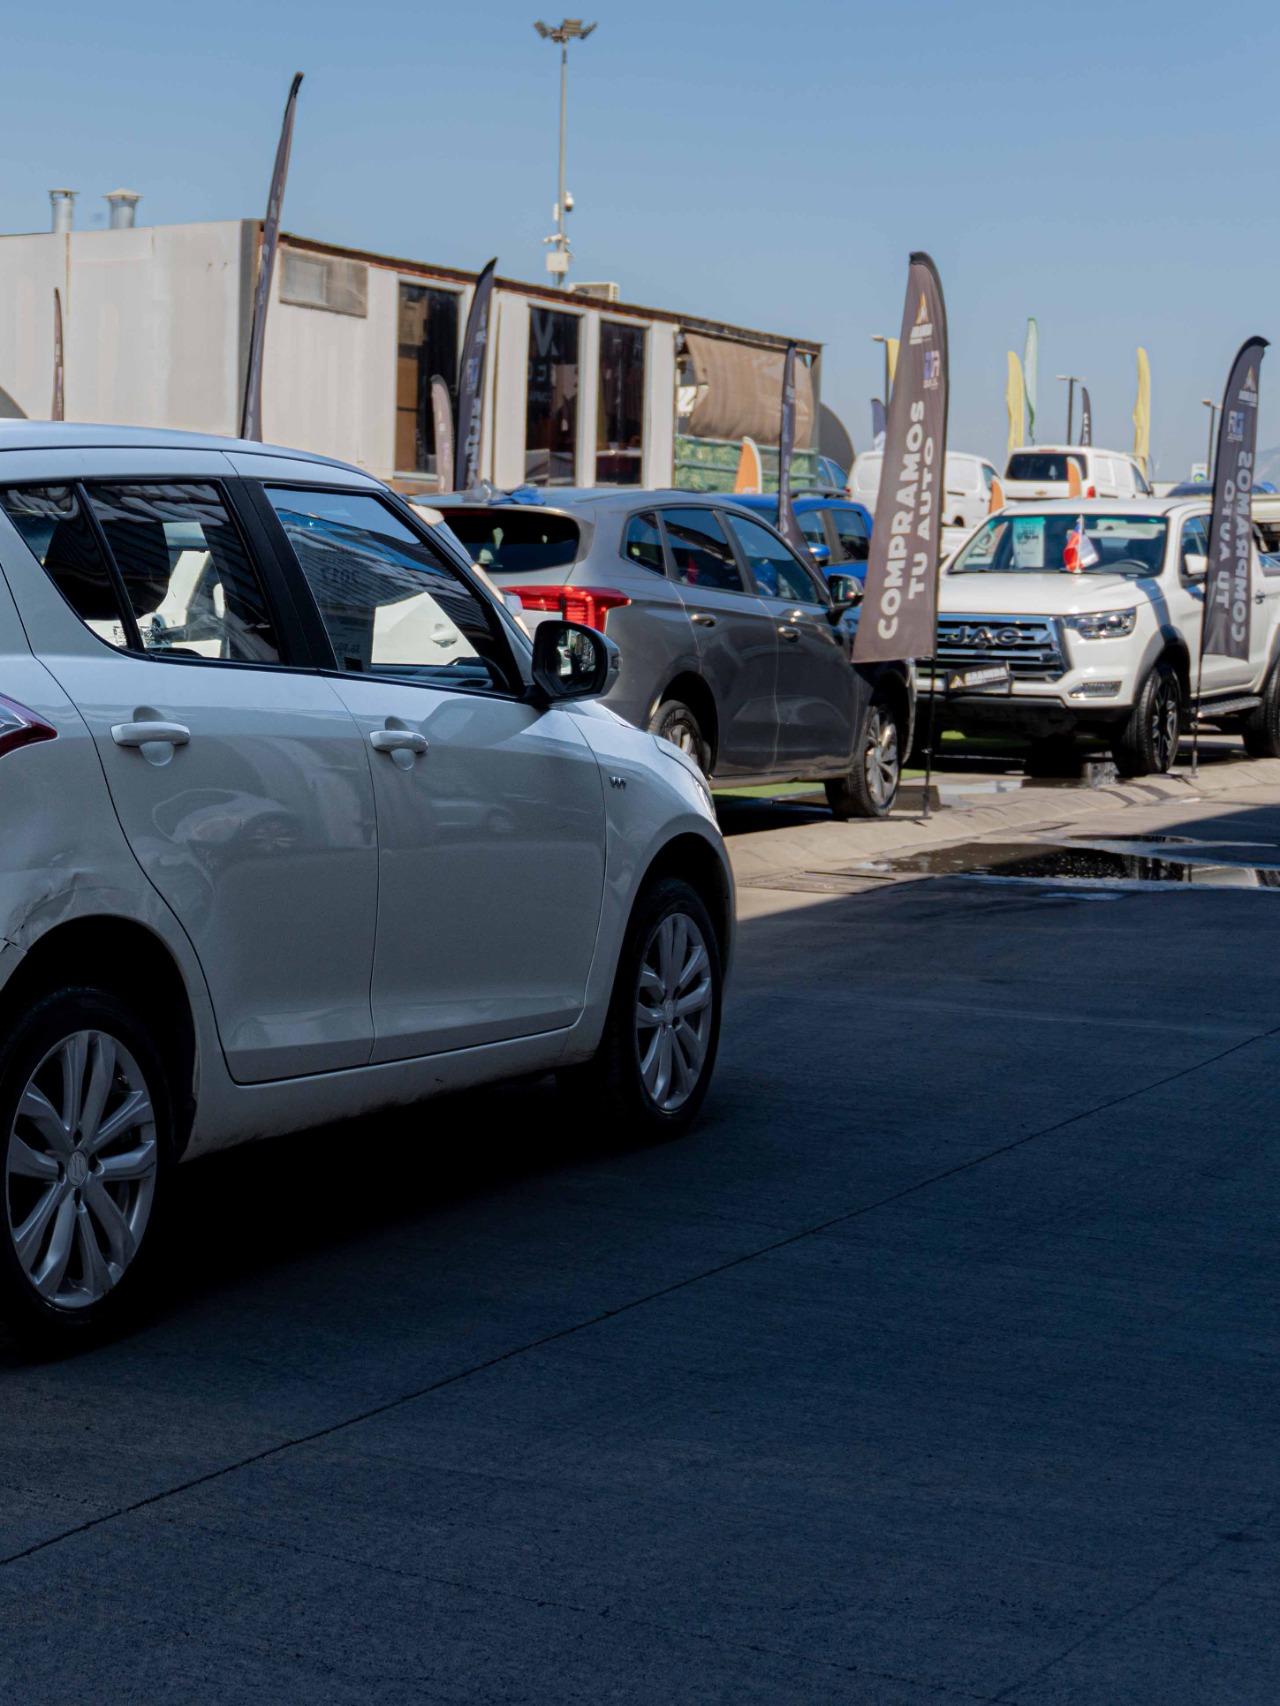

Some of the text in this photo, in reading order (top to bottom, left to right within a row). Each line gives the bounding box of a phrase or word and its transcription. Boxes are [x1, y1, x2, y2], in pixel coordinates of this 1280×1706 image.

[878, 400, 924, 640] COMPRAMOS
[908, 436, 934, 600] TU AUTO
[945, 625, 1022, 646] JAC
